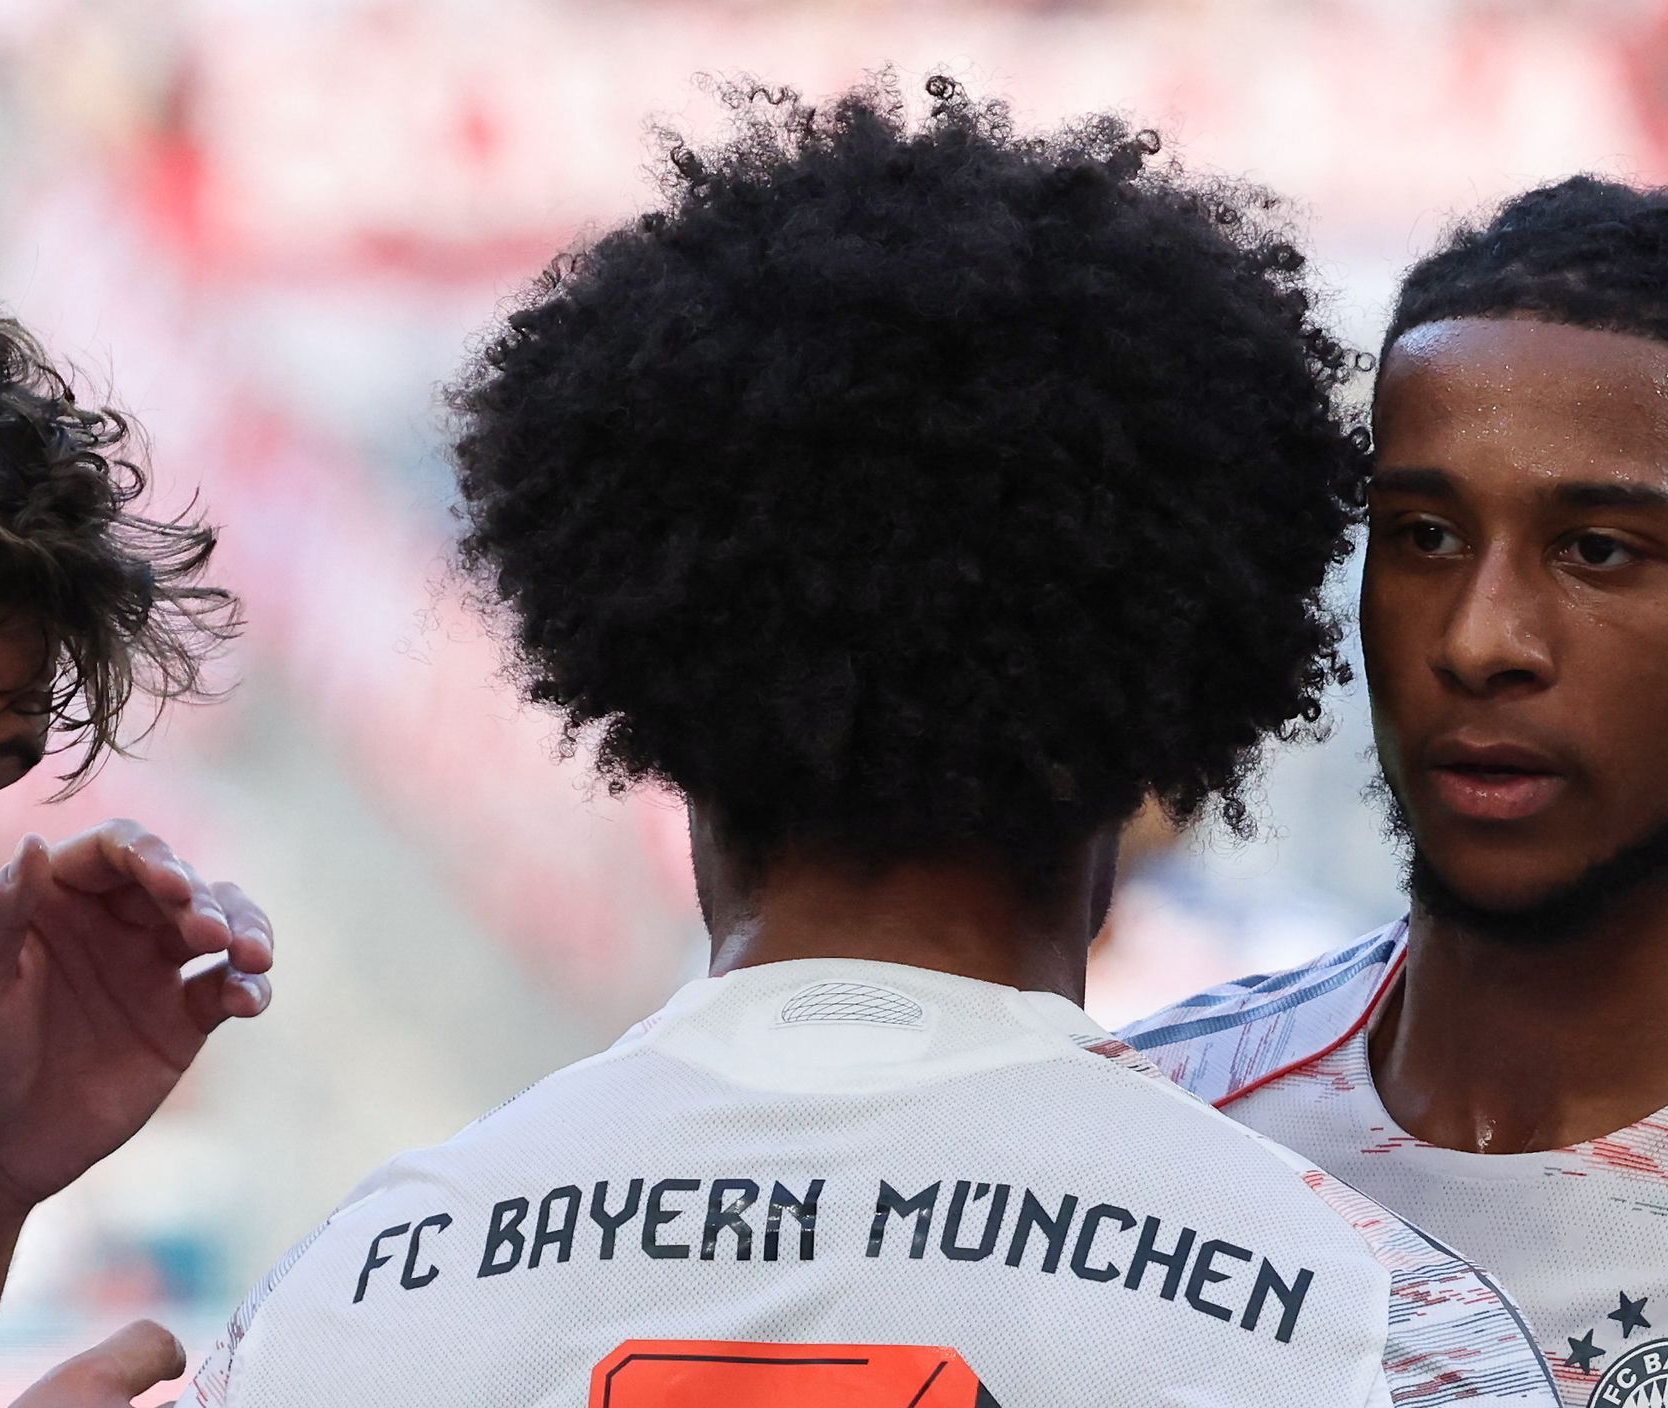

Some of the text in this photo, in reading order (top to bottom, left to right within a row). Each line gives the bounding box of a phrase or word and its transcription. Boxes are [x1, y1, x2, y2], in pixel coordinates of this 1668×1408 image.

[353, 1178, 1314, 1344] FC BAYERN MÜNCHEN
[1603, 1367, 1637, 1406] FC
